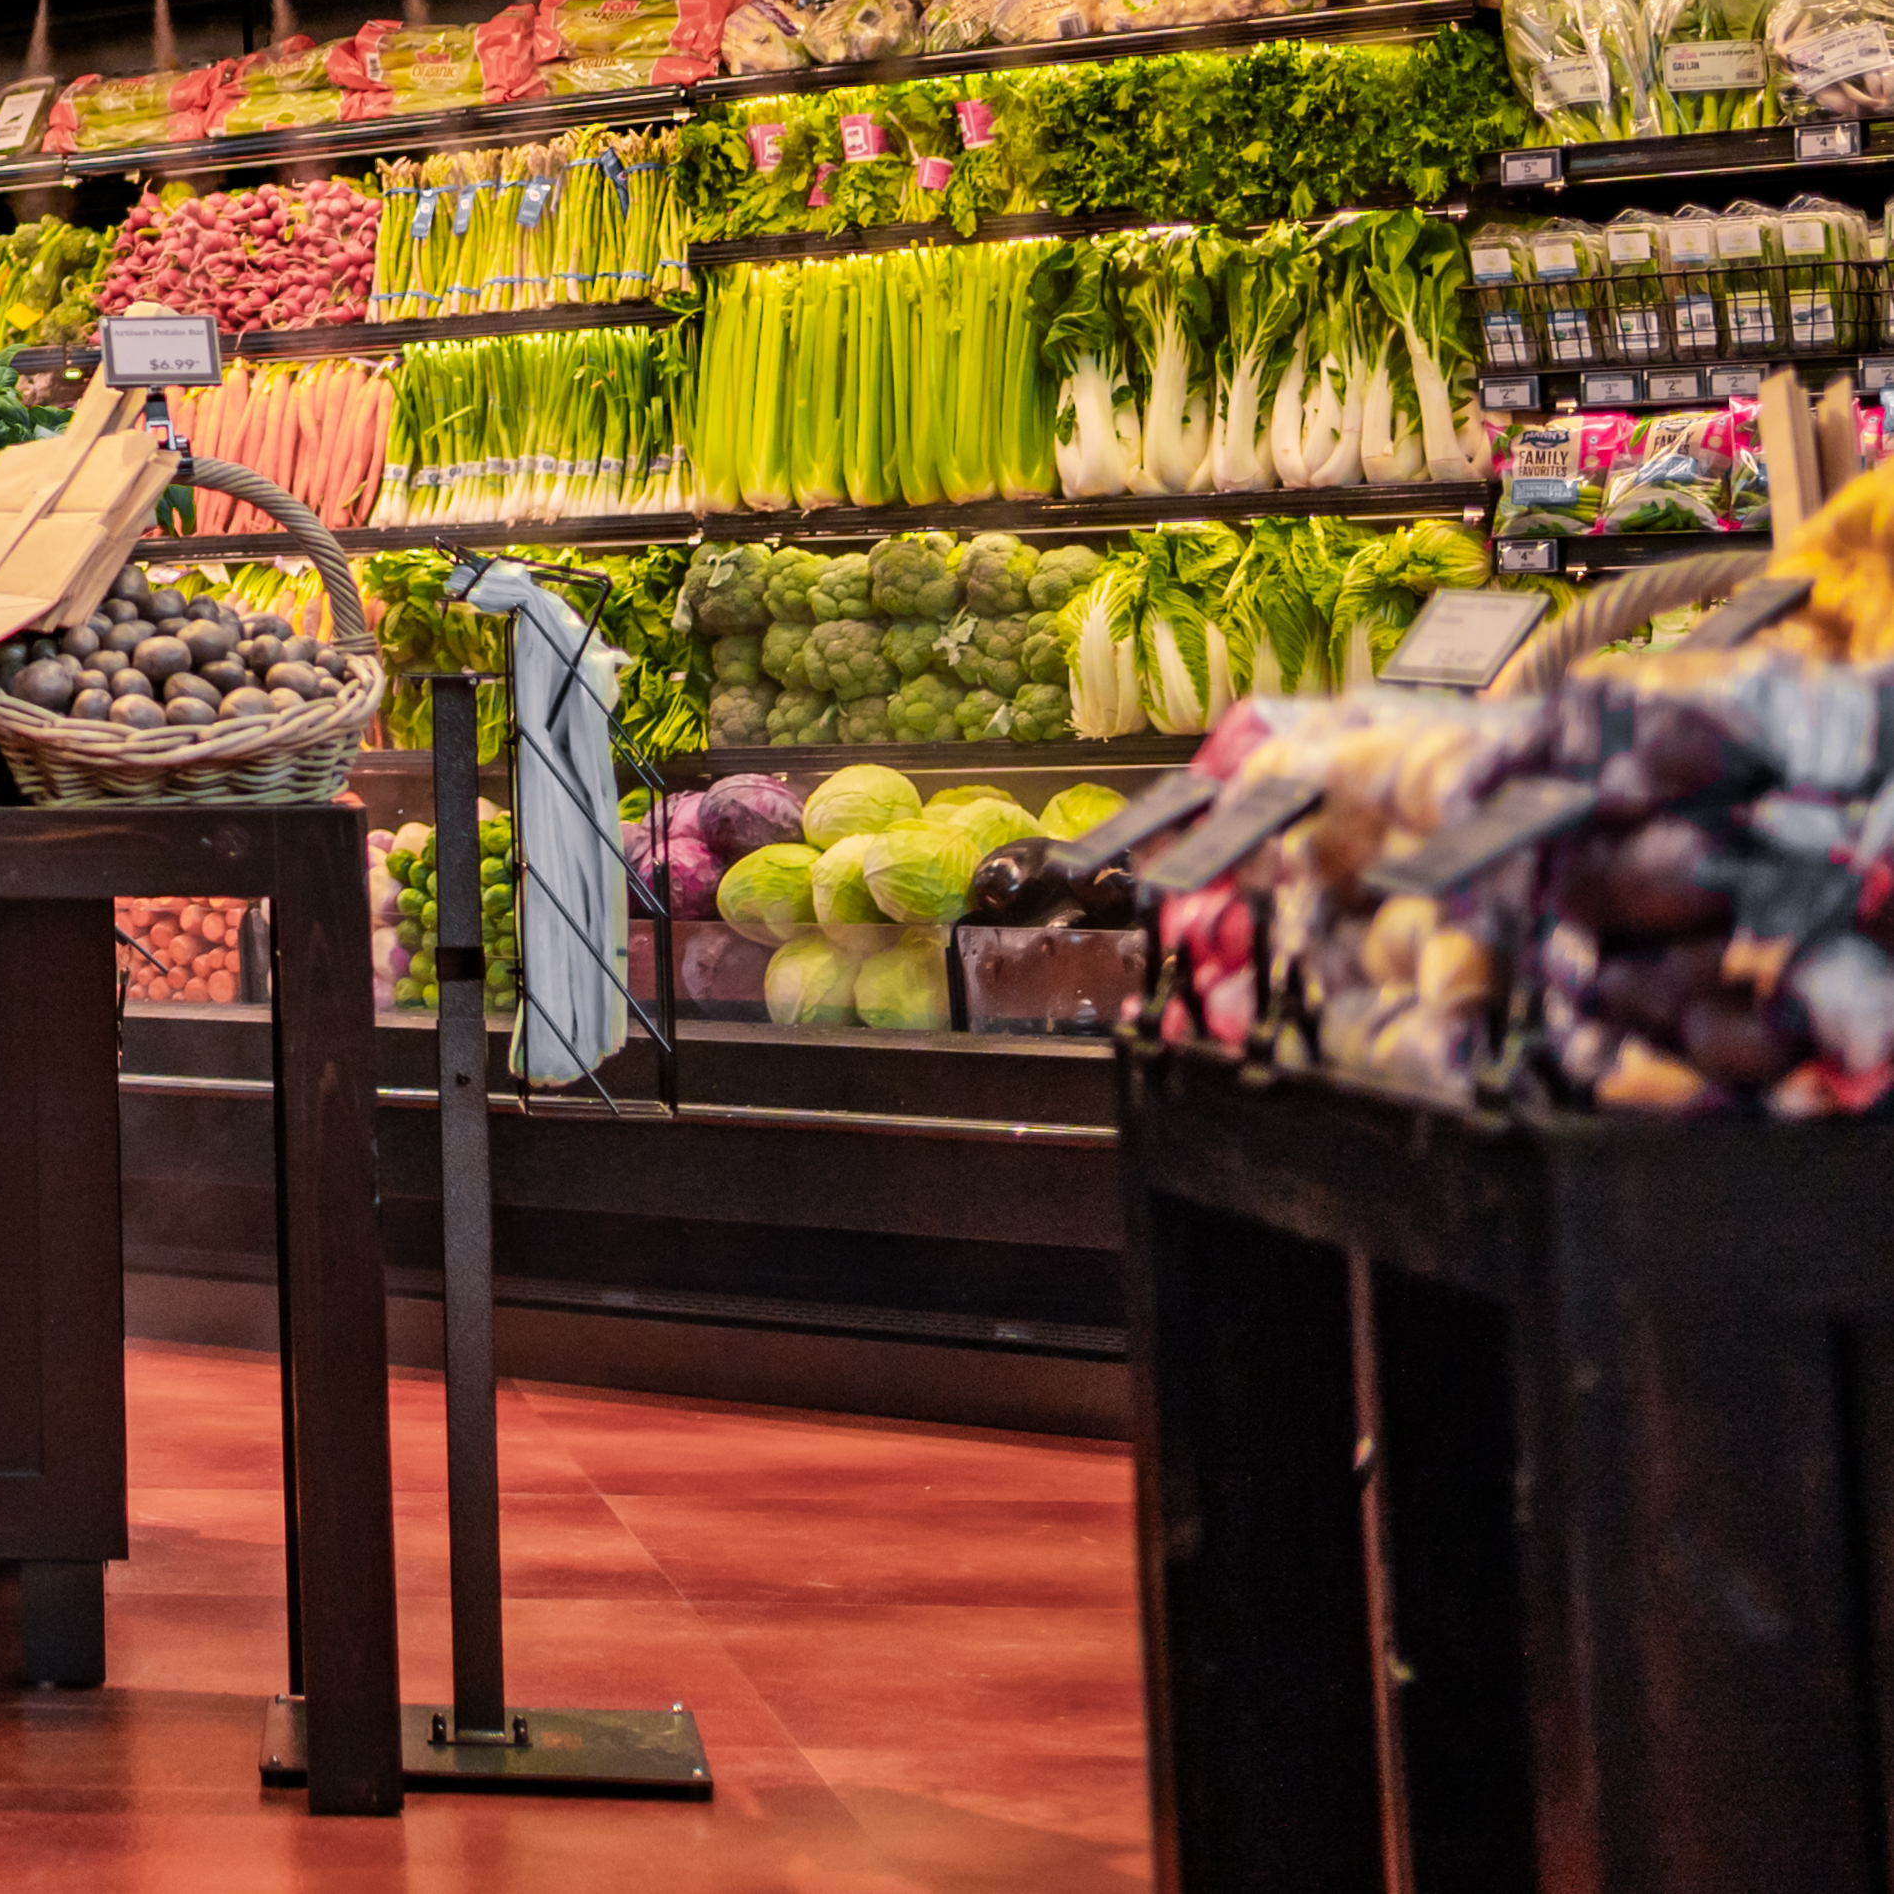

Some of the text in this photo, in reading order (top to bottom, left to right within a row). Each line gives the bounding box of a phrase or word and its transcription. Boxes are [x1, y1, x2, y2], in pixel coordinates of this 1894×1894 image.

[150, 359, 194, 371] $6.99
[1654, 432, 1695, 451] FAMY
[1519, 450, 1570, 465] FAMILY
[1518, 466, 1567, 478] FAVORITES
